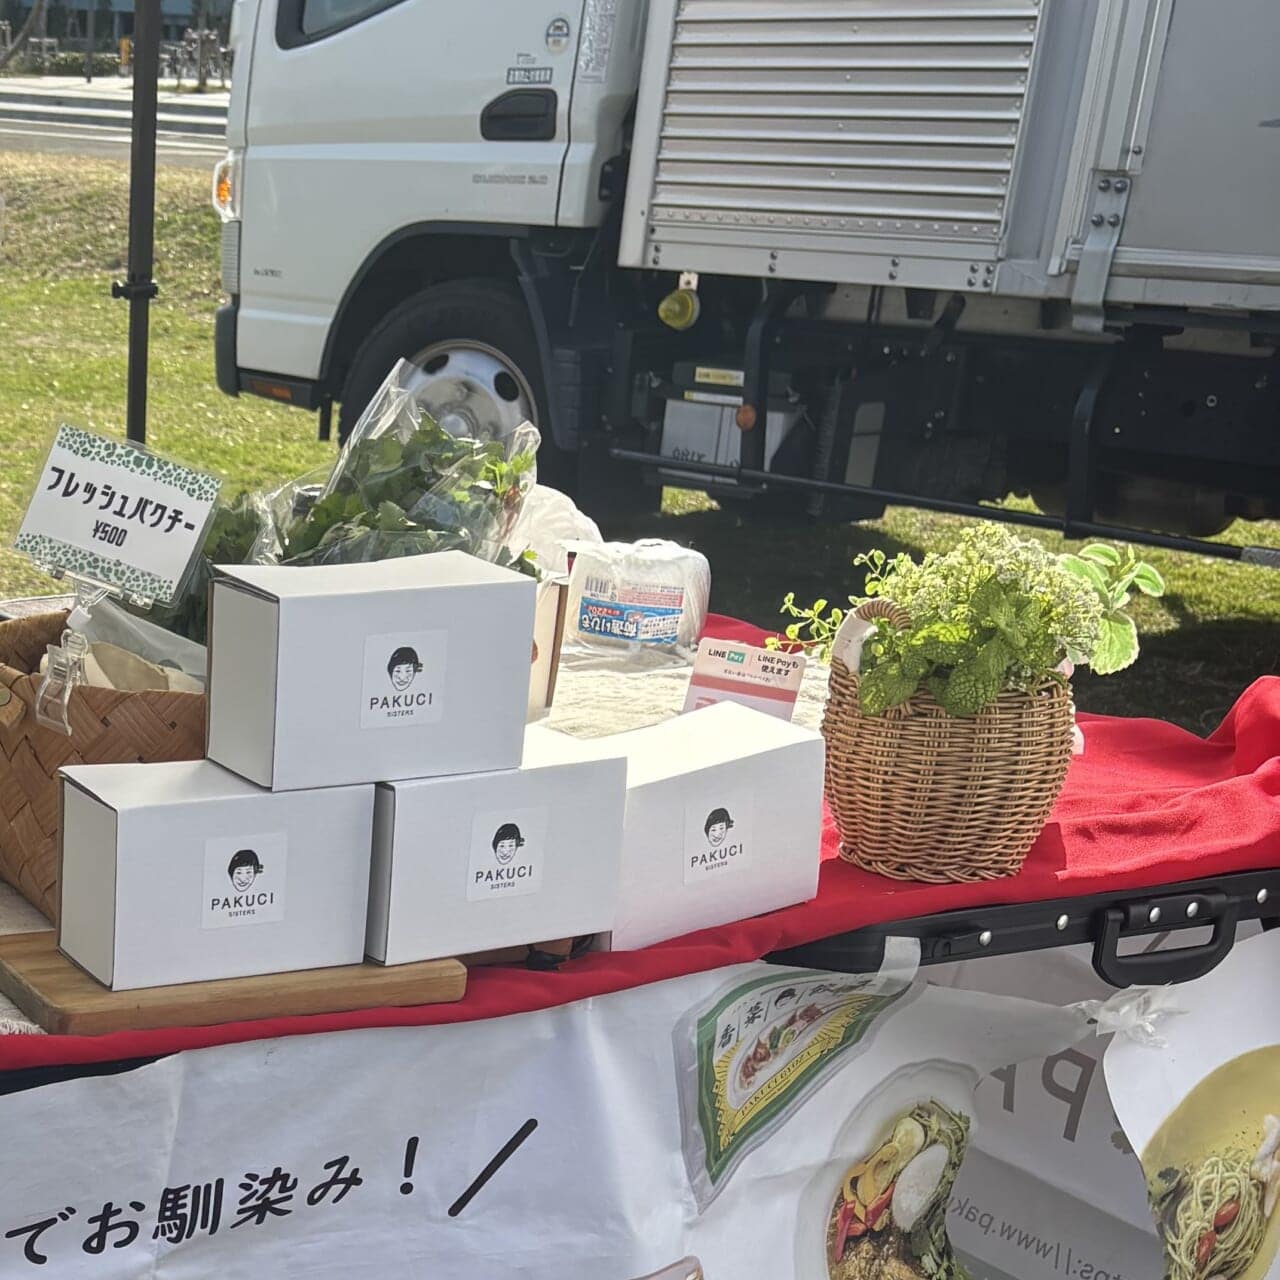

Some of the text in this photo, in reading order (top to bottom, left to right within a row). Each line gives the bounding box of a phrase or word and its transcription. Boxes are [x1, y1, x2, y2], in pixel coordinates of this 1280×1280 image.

[47, 465, 196, 534] フレッシュパクチー
[92, 519, 129, 548] ¥500
[708, 648, 727, 659] LINE
[757, 654, 776, 665] LINE
[369, 692, 433, 711] PAKUCI
[690, 843, 744, 868] PAKUCI
[474, 865, 533, 884] PAKUCI
[211, 892, 274, 911] PAKUCI
